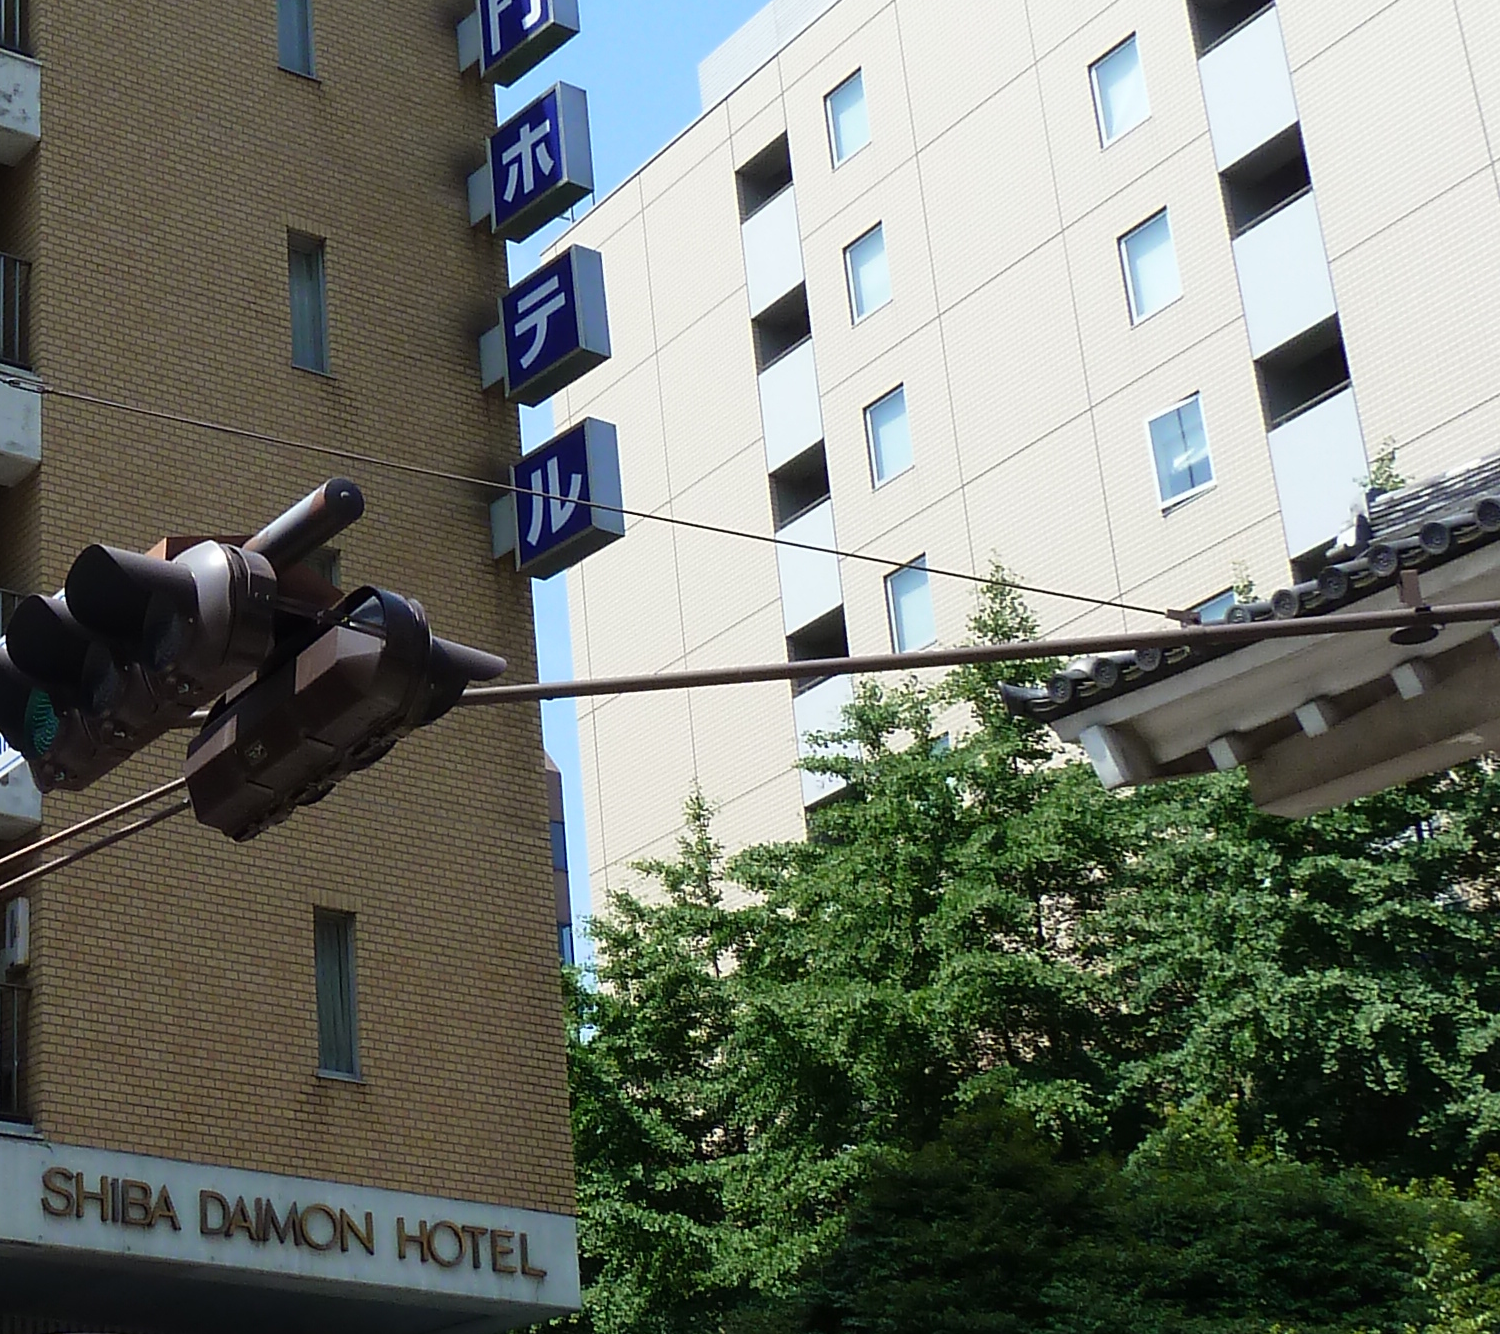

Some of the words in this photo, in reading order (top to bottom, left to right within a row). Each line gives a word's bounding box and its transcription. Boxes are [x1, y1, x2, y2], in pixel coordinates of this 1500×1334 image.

[41, 1166, 182, 1231] SHIBA
[200, 1189, 375, 1256] DAIMON
[396, 1216, 548, 1278] HOTEL
